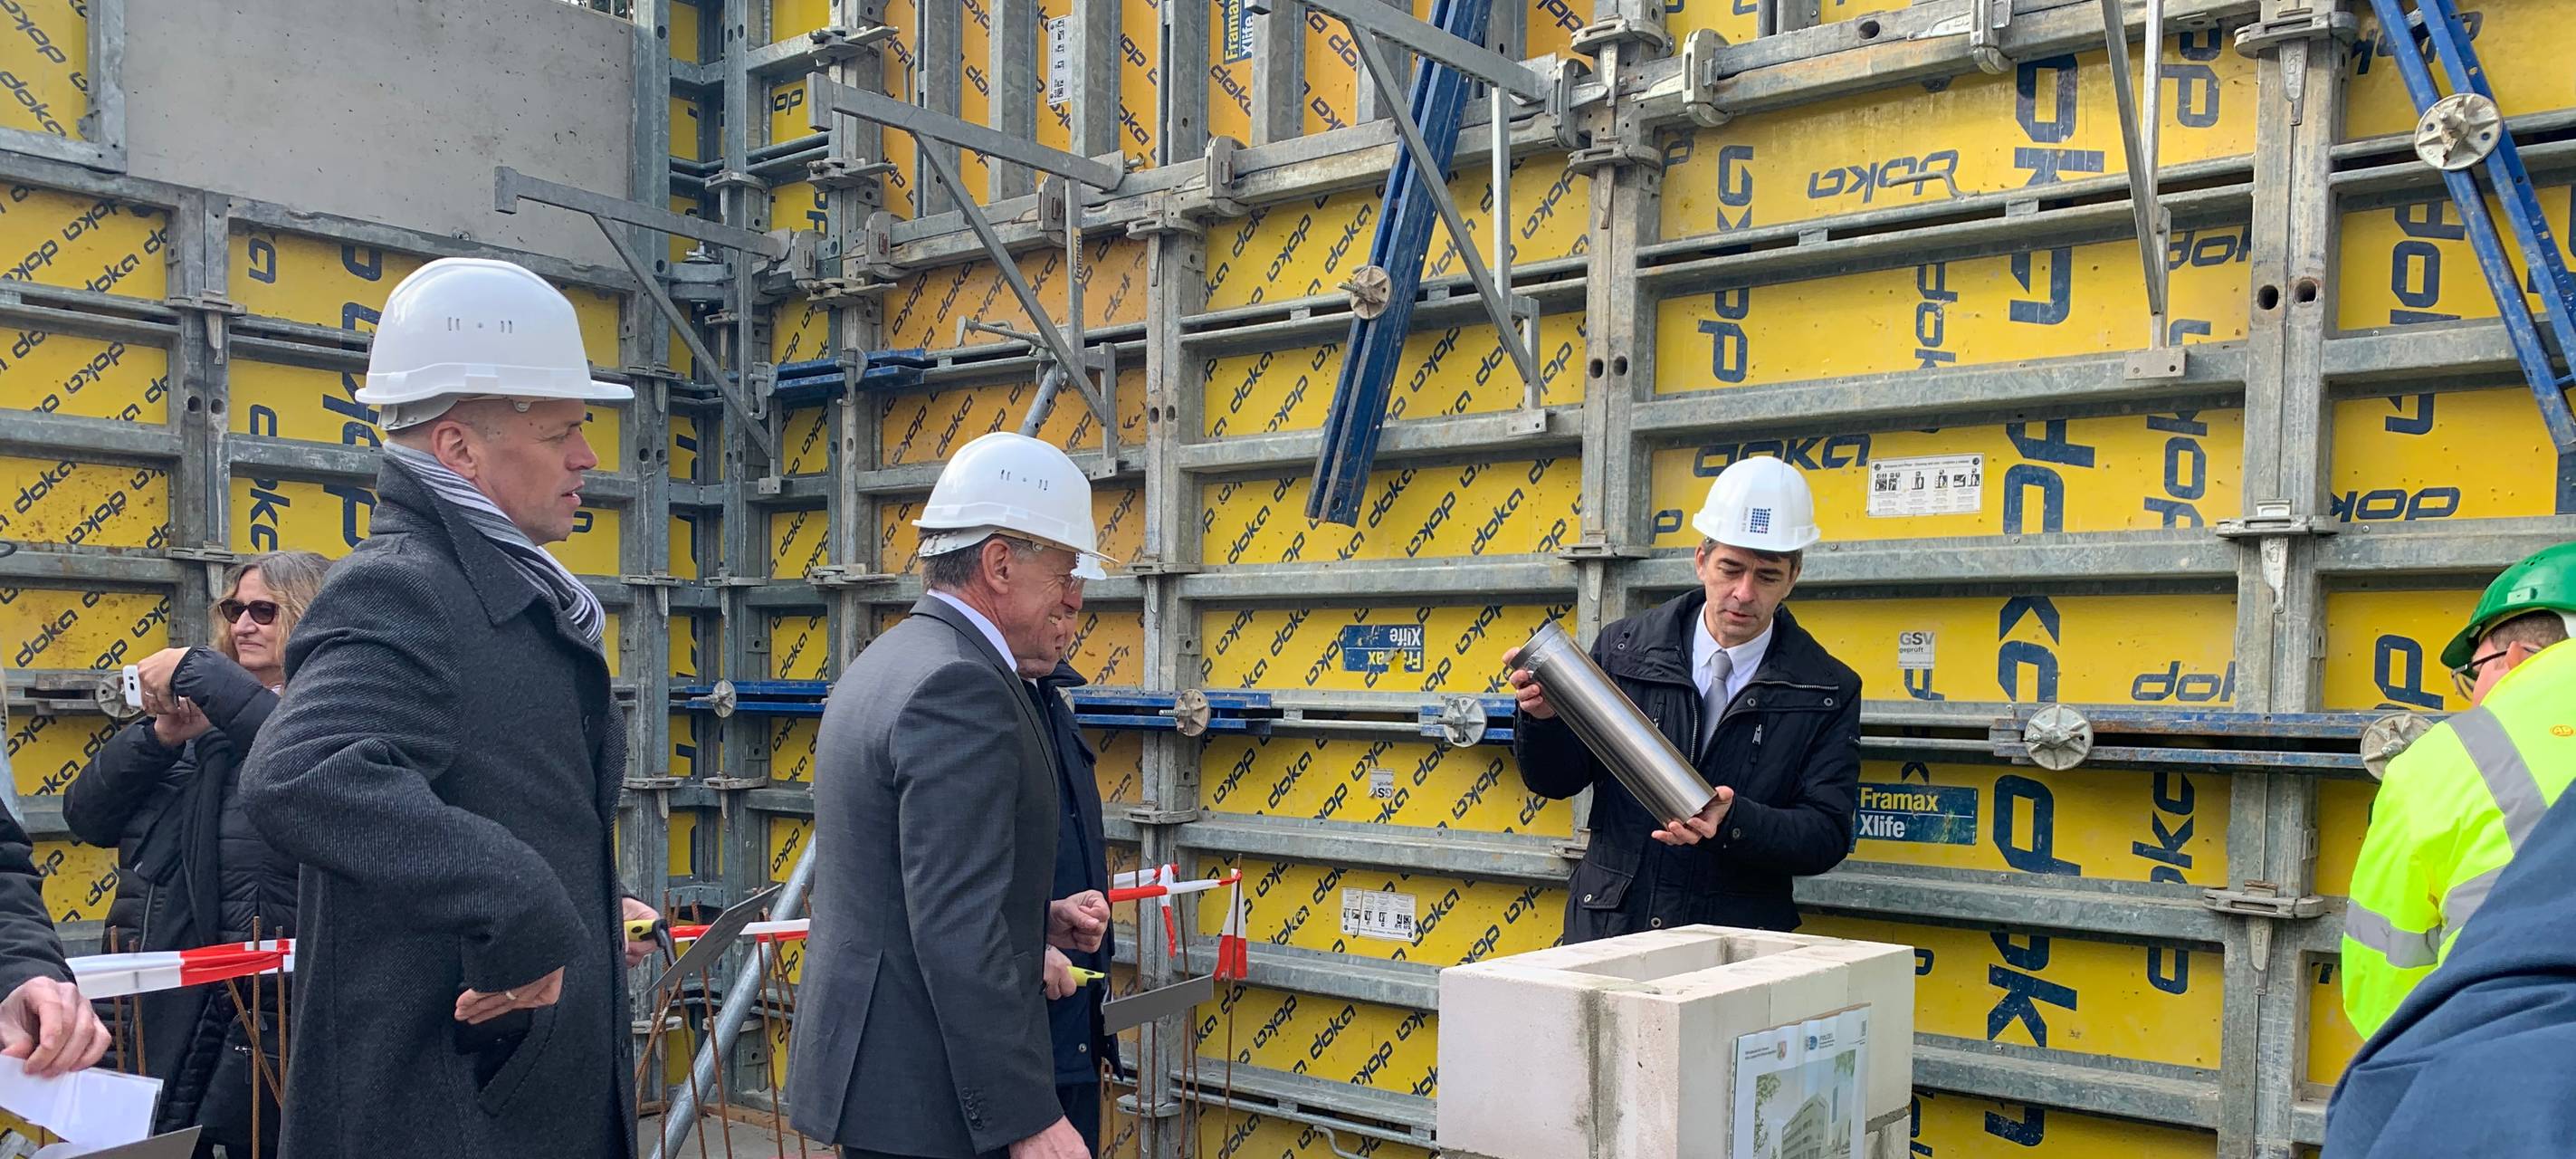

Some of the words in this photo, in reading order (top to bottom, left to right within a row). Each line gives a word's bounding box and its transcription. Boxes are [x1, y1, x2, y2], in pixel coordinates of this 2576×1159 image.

[1808, 149, 1959, 203] doka
[1267, 214, 1312, 283] doka
[1324, 203, 1372, 274] doka
[893, 272, 928, 335] doka
[937, 262, 973, 323] doka
[12, 330, 45, 359] do
[63, 341, 126, 394] doka
[1409, 326, 1461, 393] doka
[1230, 351, 1274, 414] doka
[936, 395, 974, 458] doka
[64, 491, 127, 544] doka
[1405, 491, 1456, 558] doka
[1471, 487, 1525, 556] doka
[2332, 486, 2460, 522] dok
[1227, 505, 1271, 565] doka
[15, 609, 79, 668] doka
[780, 632, 807, 679] doka
[1368, 651, 1421, 669] Frax
[1389, 627, 1421, 647] Xlife
[1899, 646, 1923, 654] geprüft
[1900, 632, 1935, 646] GSV
[1213, 748, 1255, 805] doka
[1268, 751, 1312, 809] doka
[1350, 741, 1394, 782] oka
[1451, 757, 1503, 820] doka
[1369, 787, 1409, 824] oka
[1858, 813, 1906, 838] Xlife
[1859, 787, 1938, 812] Framax
[772, 828, 800, 872] doka
[1253, 994, 1298, 1049] doka
[1310, 1003, 1357, 1060] doka
